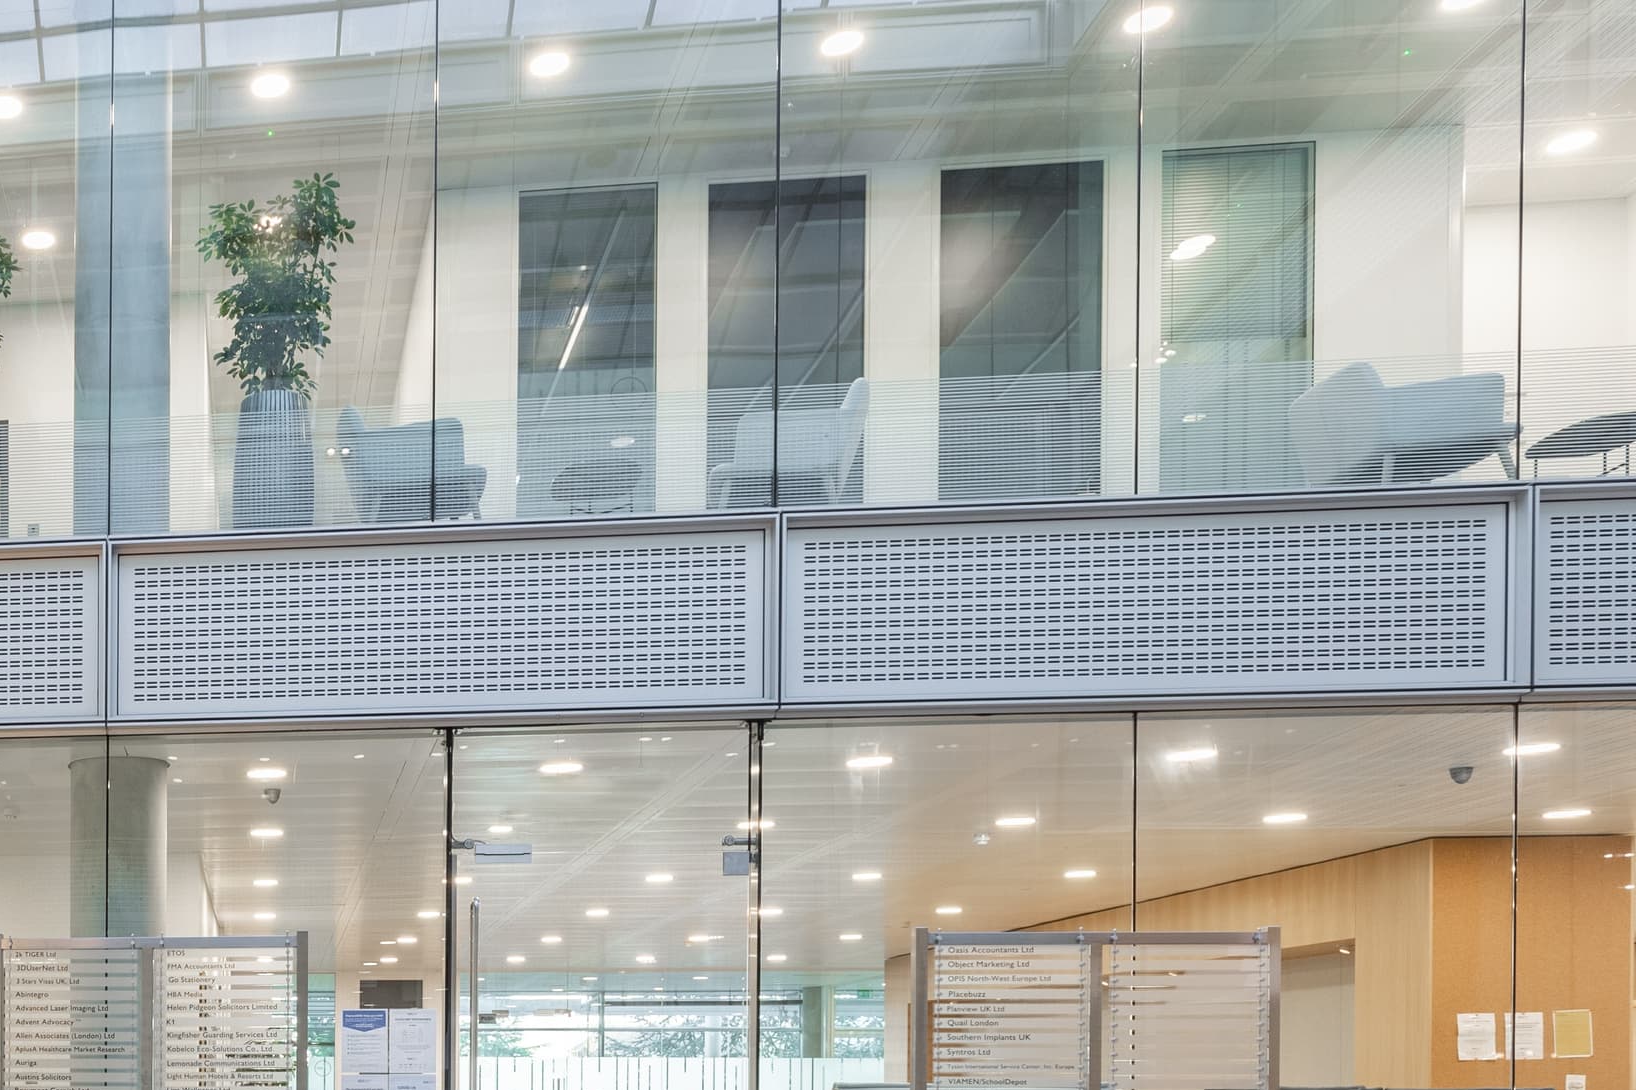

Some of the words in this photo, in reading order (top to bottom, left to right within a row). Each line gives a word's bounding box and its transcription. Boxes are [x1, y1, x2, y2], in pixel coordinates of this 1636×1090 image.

[70, 1005, 96, 1013] Imaging
[189, 1004, 216, 1012] Pidgeon
[15, 1059, 37, 1067] Auriga
